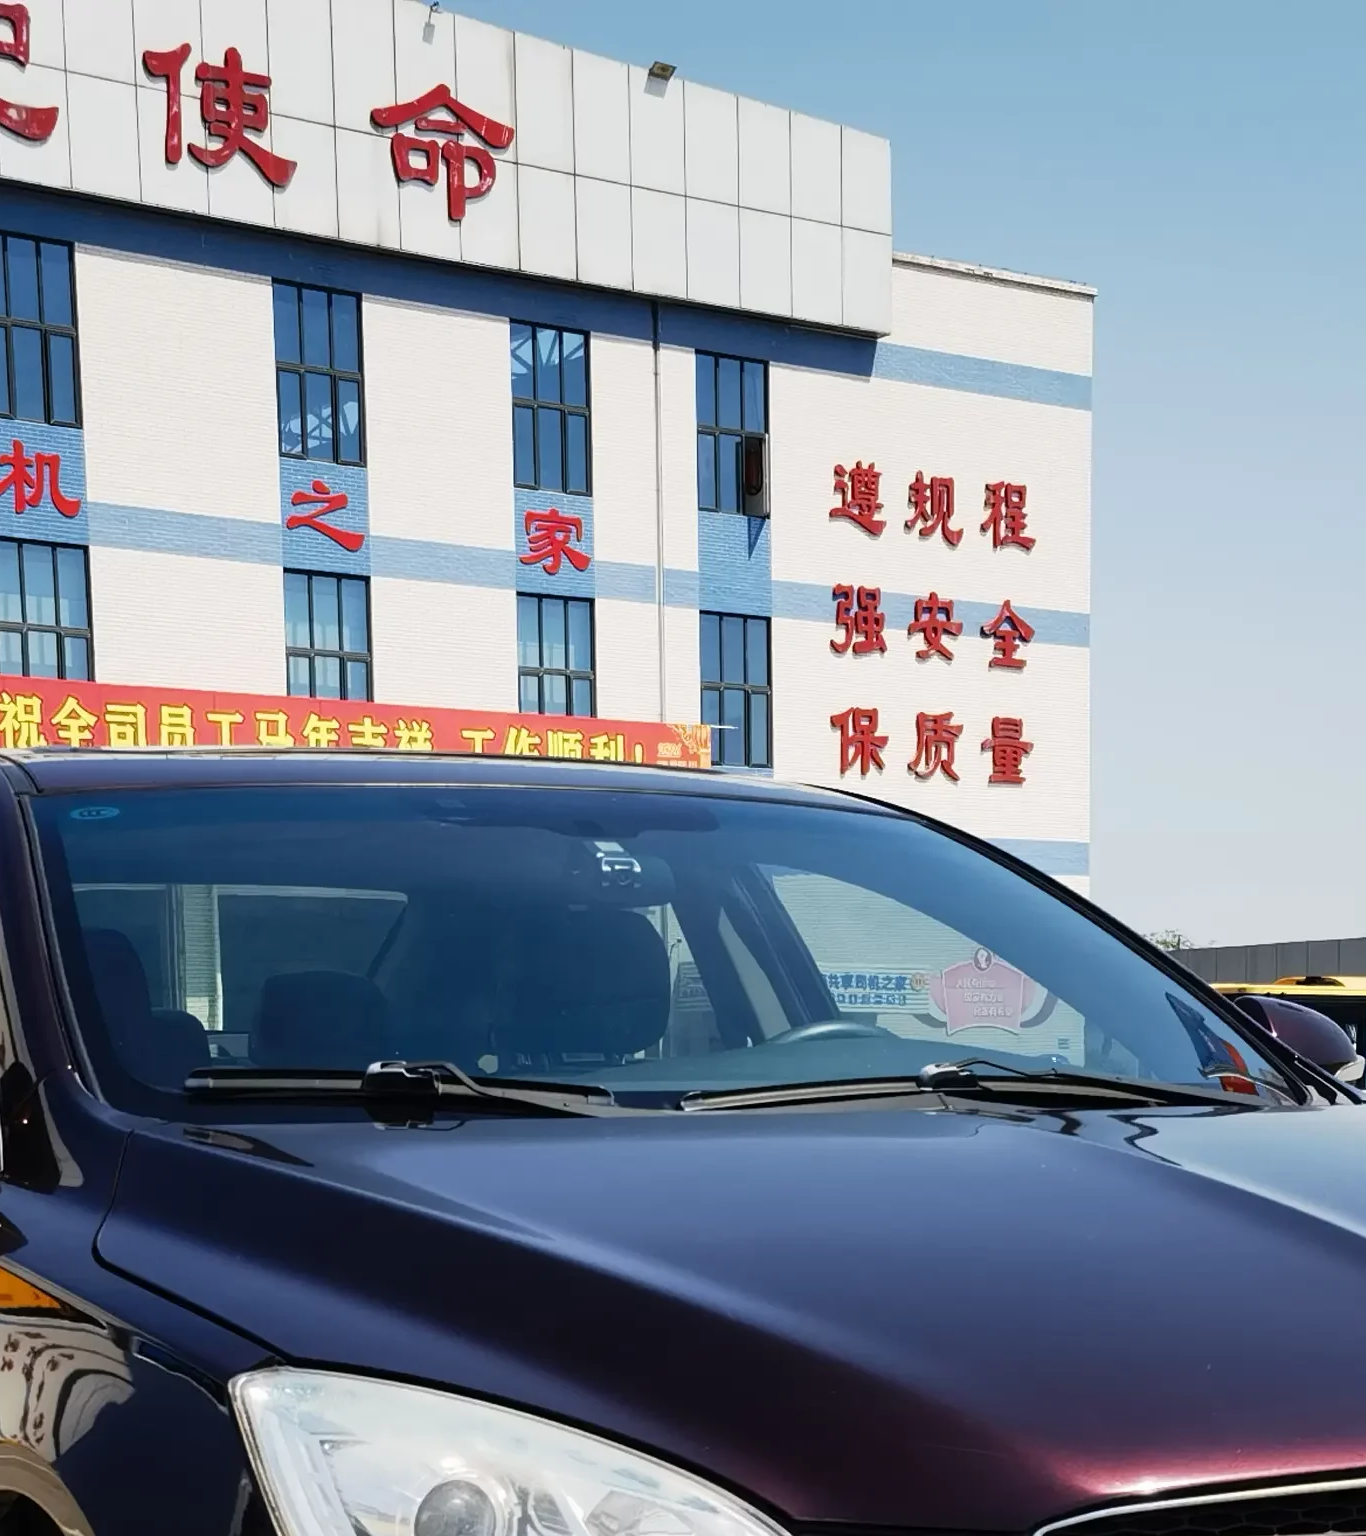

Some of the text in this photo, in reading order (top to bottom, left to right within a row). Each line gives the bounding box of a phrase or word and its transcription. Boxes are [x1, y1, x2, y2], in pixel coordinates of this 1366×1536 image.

[829, 461, 1036, 552] 遵规程
[829, 583, 1035, 669] 强安全
[829, 706, 1034, 786] 保质量
